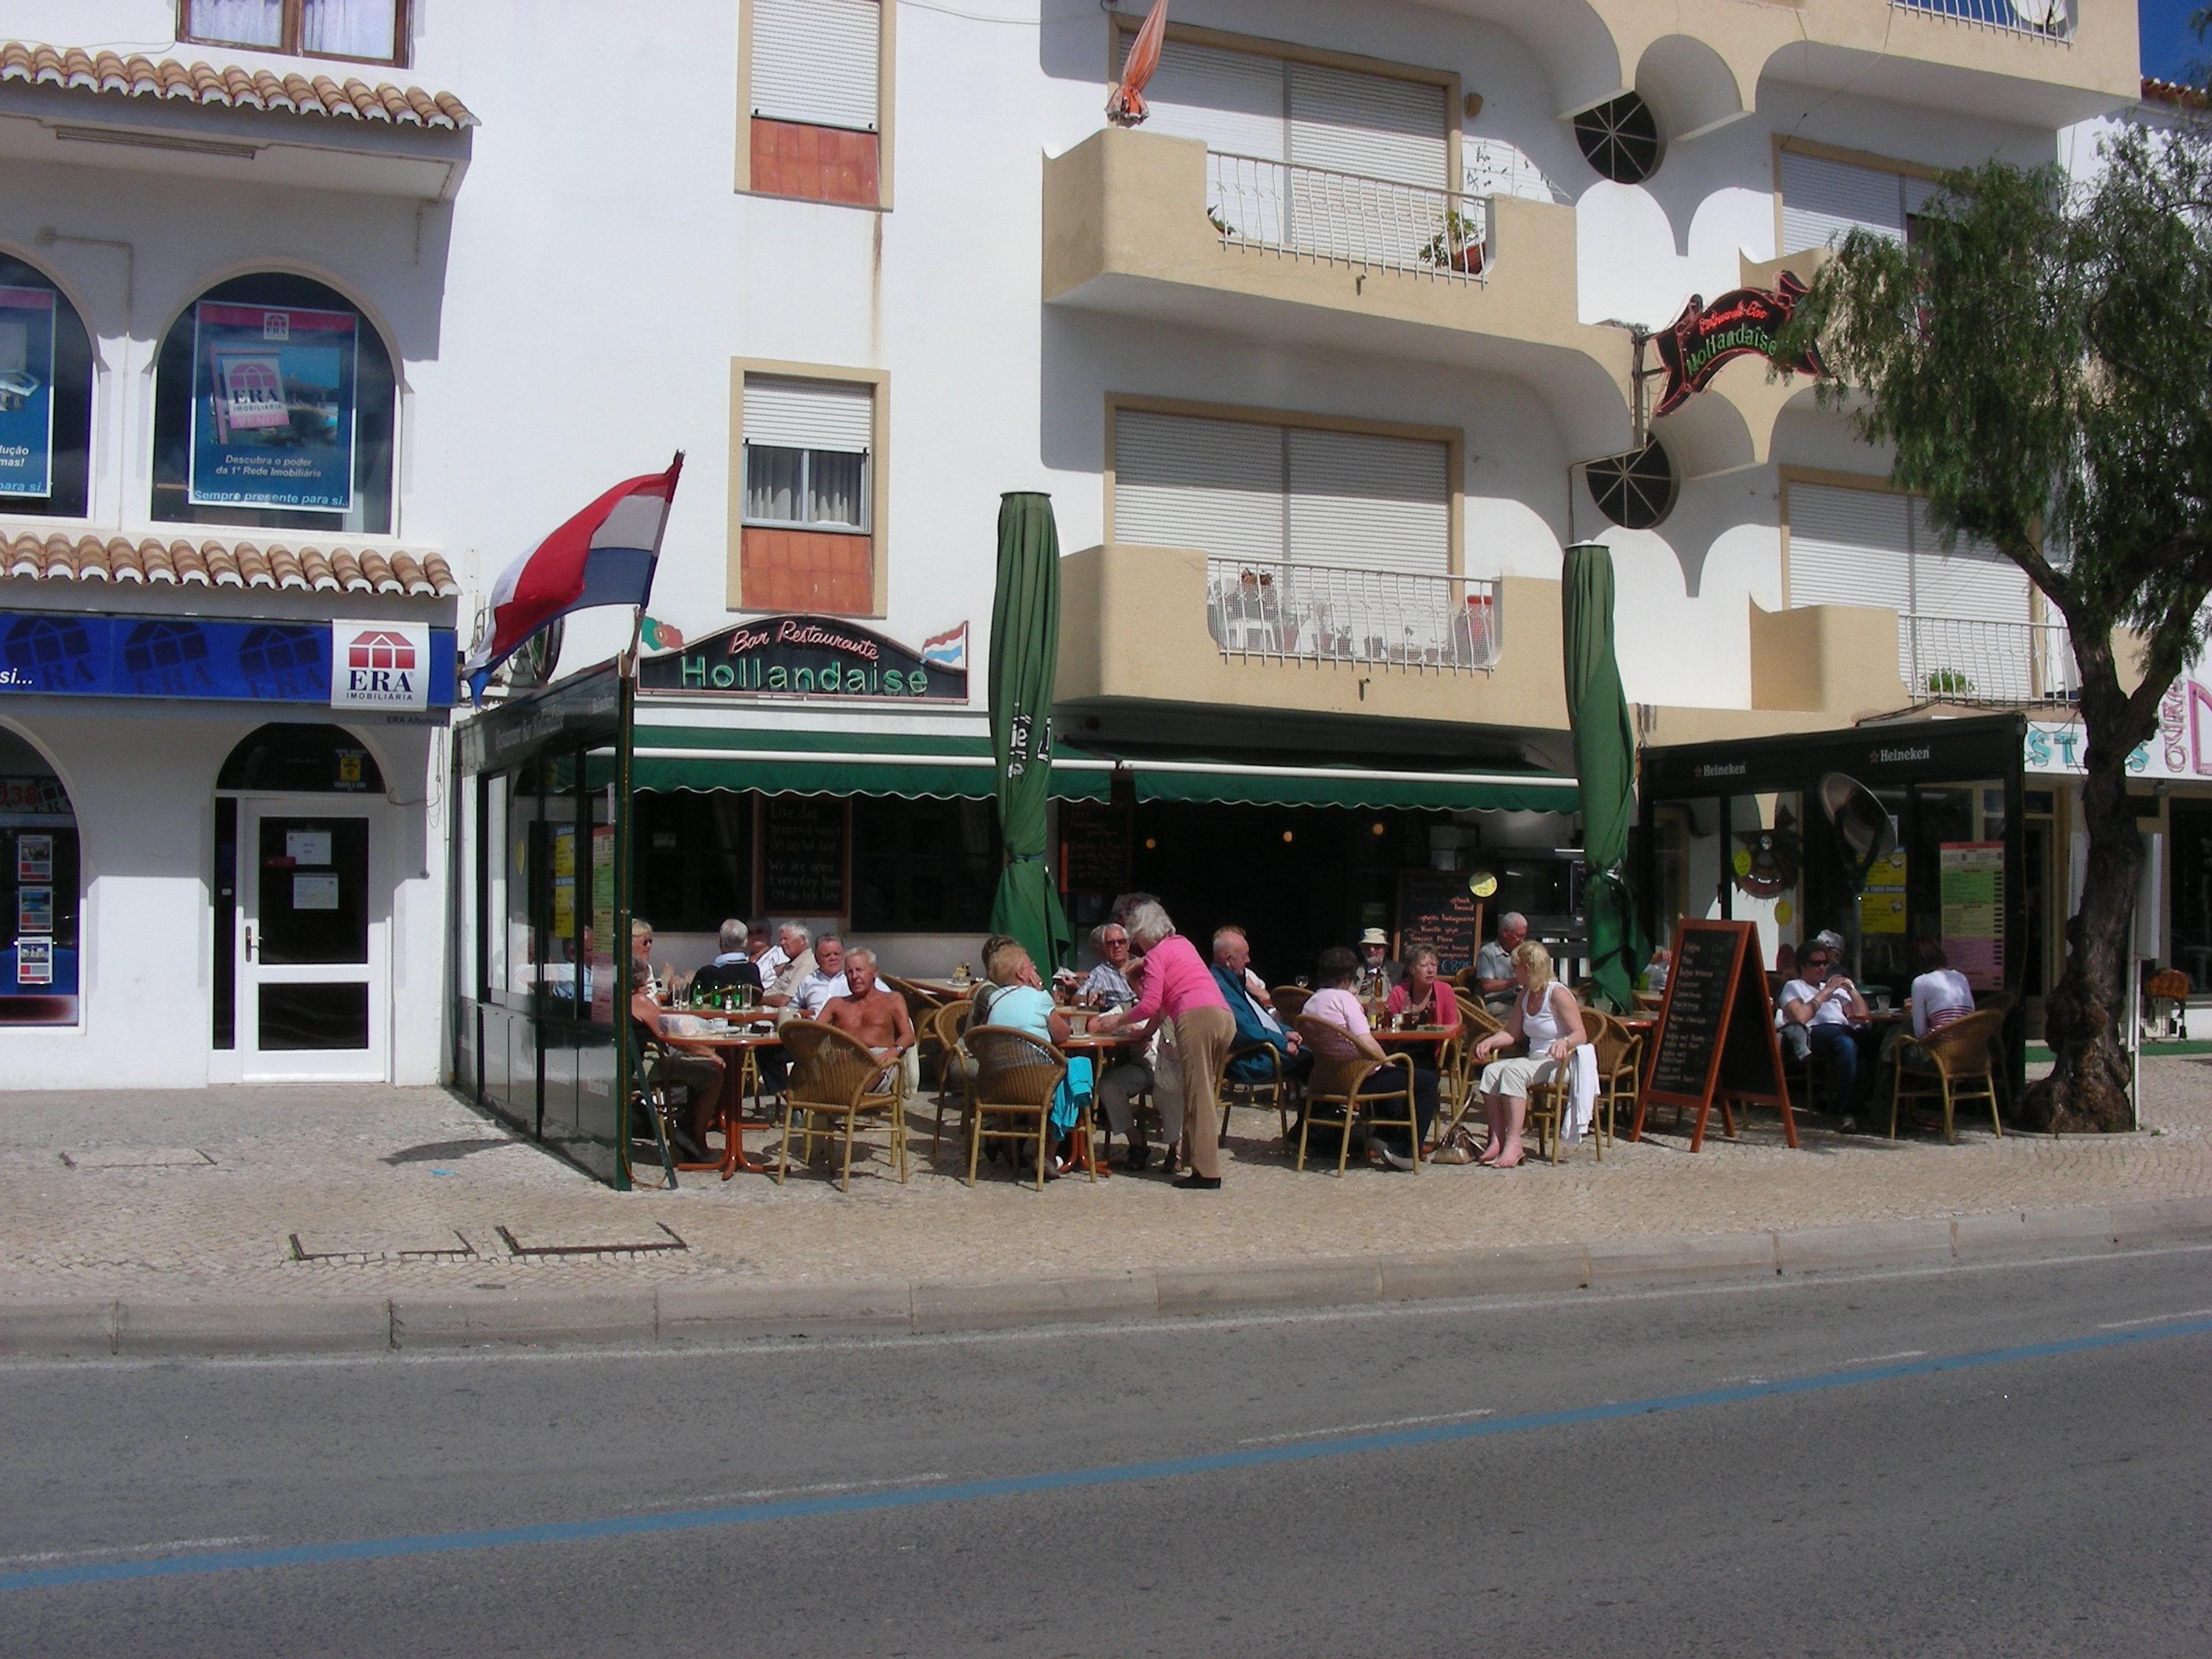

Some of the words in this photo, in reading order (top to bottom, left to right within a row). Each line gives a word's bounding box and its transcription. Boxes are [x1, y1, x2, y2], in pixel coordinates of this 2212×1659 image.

[233, 390, 279, 404] ERA
[225, 454, 273, 465] Descubra
[284, 458, 313, 467] poder
[216, 466, 228, 474] da
[243, 467, 269, 476] Rede
[270, 466, 322, 478] Imobiliária
[195, 490, 241, 501] Sempre
[244, 493, 298, 504] presente
[301, 494, 328, 505] para
[728, 629, 770, 654] Bar
[776, 621, 880, 660] Restaurante
[348, 670, 413, 693] ERA
[681, 656, 928, 696] Hollandaise
[387, 716, 405, 724] ERA
[408, 716, 445, 726] Albufeira
[1881, 747, 1930, 762] Heineken
[1703, 763, 1746, 777] Heineken
